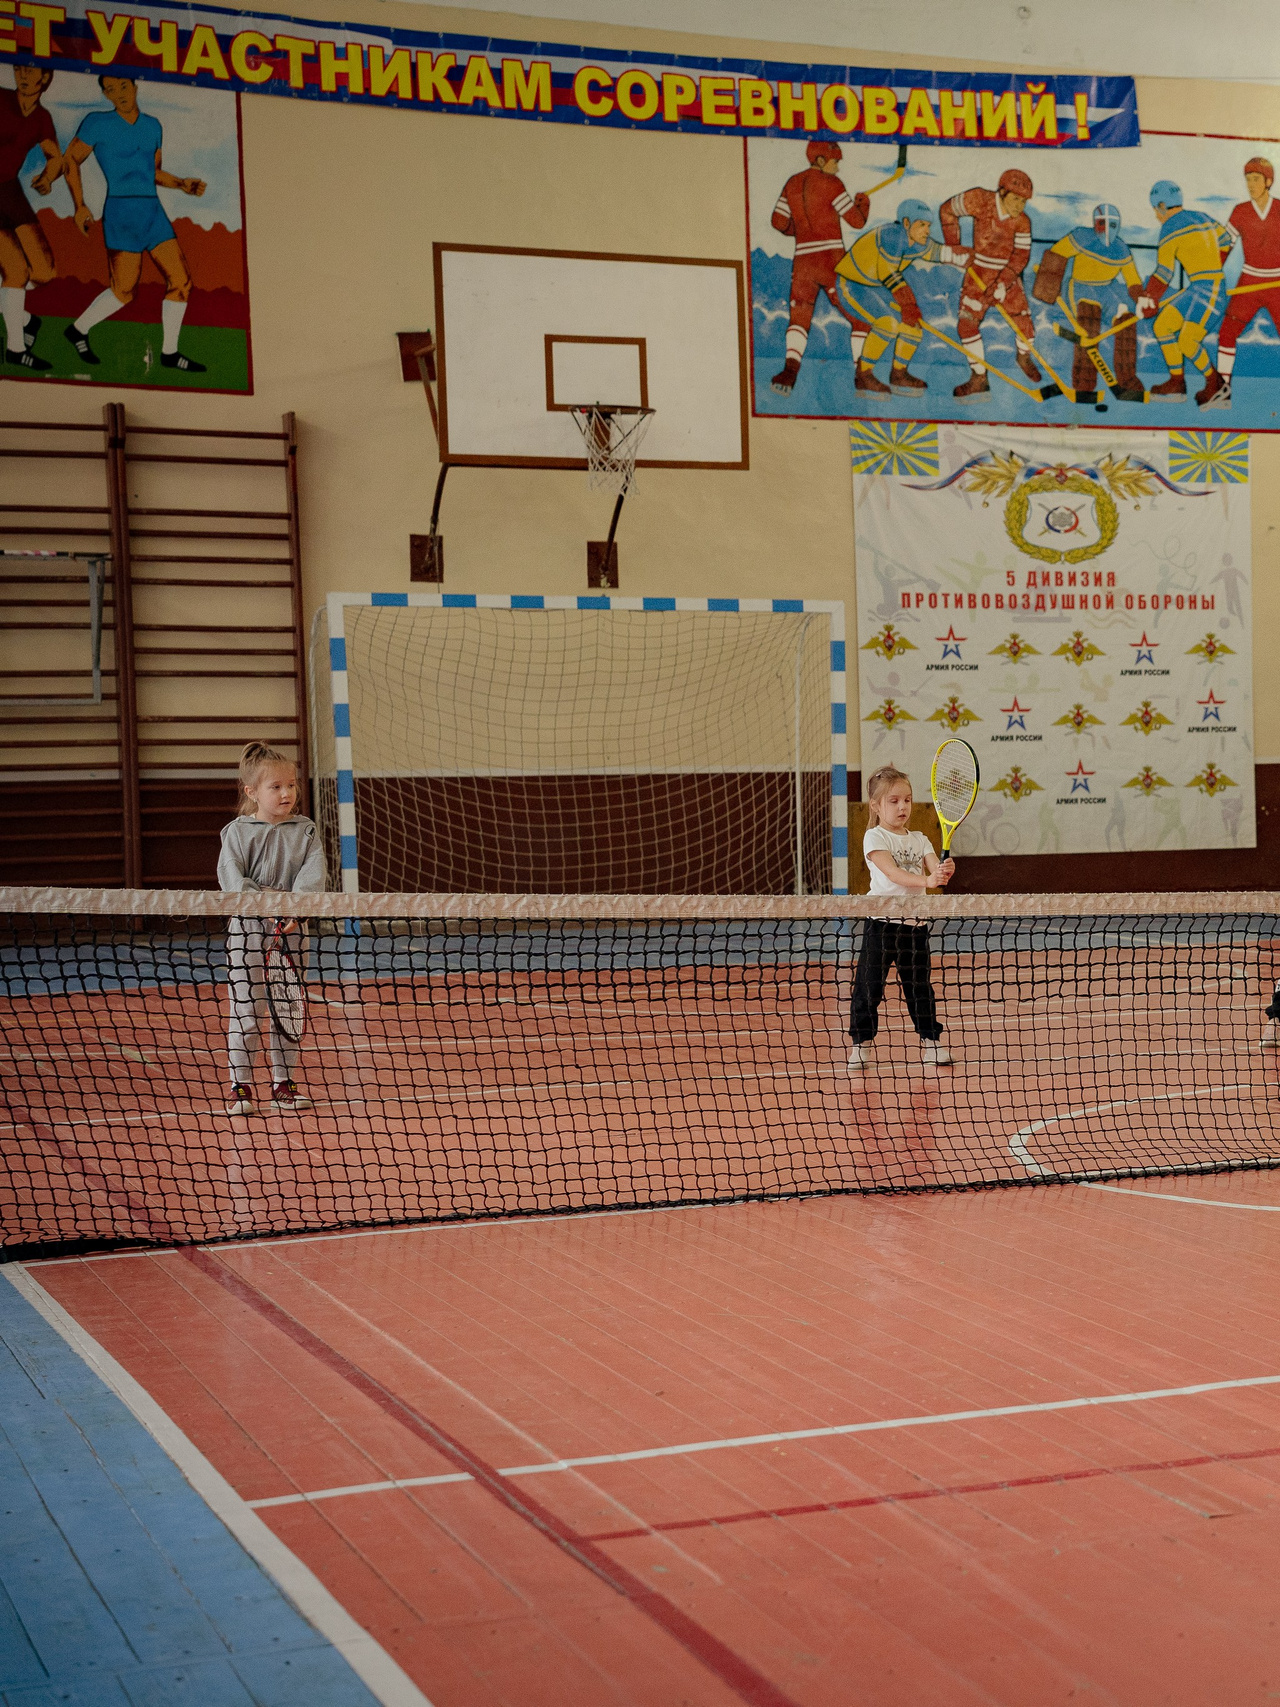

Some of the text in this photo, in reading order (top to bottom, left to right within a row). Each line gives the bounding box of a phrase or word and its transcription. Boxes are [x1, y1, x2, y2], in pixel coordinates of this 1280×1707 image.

[86, 11, 553, 112] УЧАСТНИКАМ
[573, 66, 1058, 139] СОРЕВНОВАНИЙ
[1006, 570, 1116, 588] 5 ДИВИЗИЯ
[901, 590, 1215, 612] ПРОТИВОВОЗДУШНОЙ ОБОРОНЫ
[990, 734, 1043, 742] АРМИЯ РОССИИ
[1055, 797, 1107, 805] АРМИЯ РОССИИ
